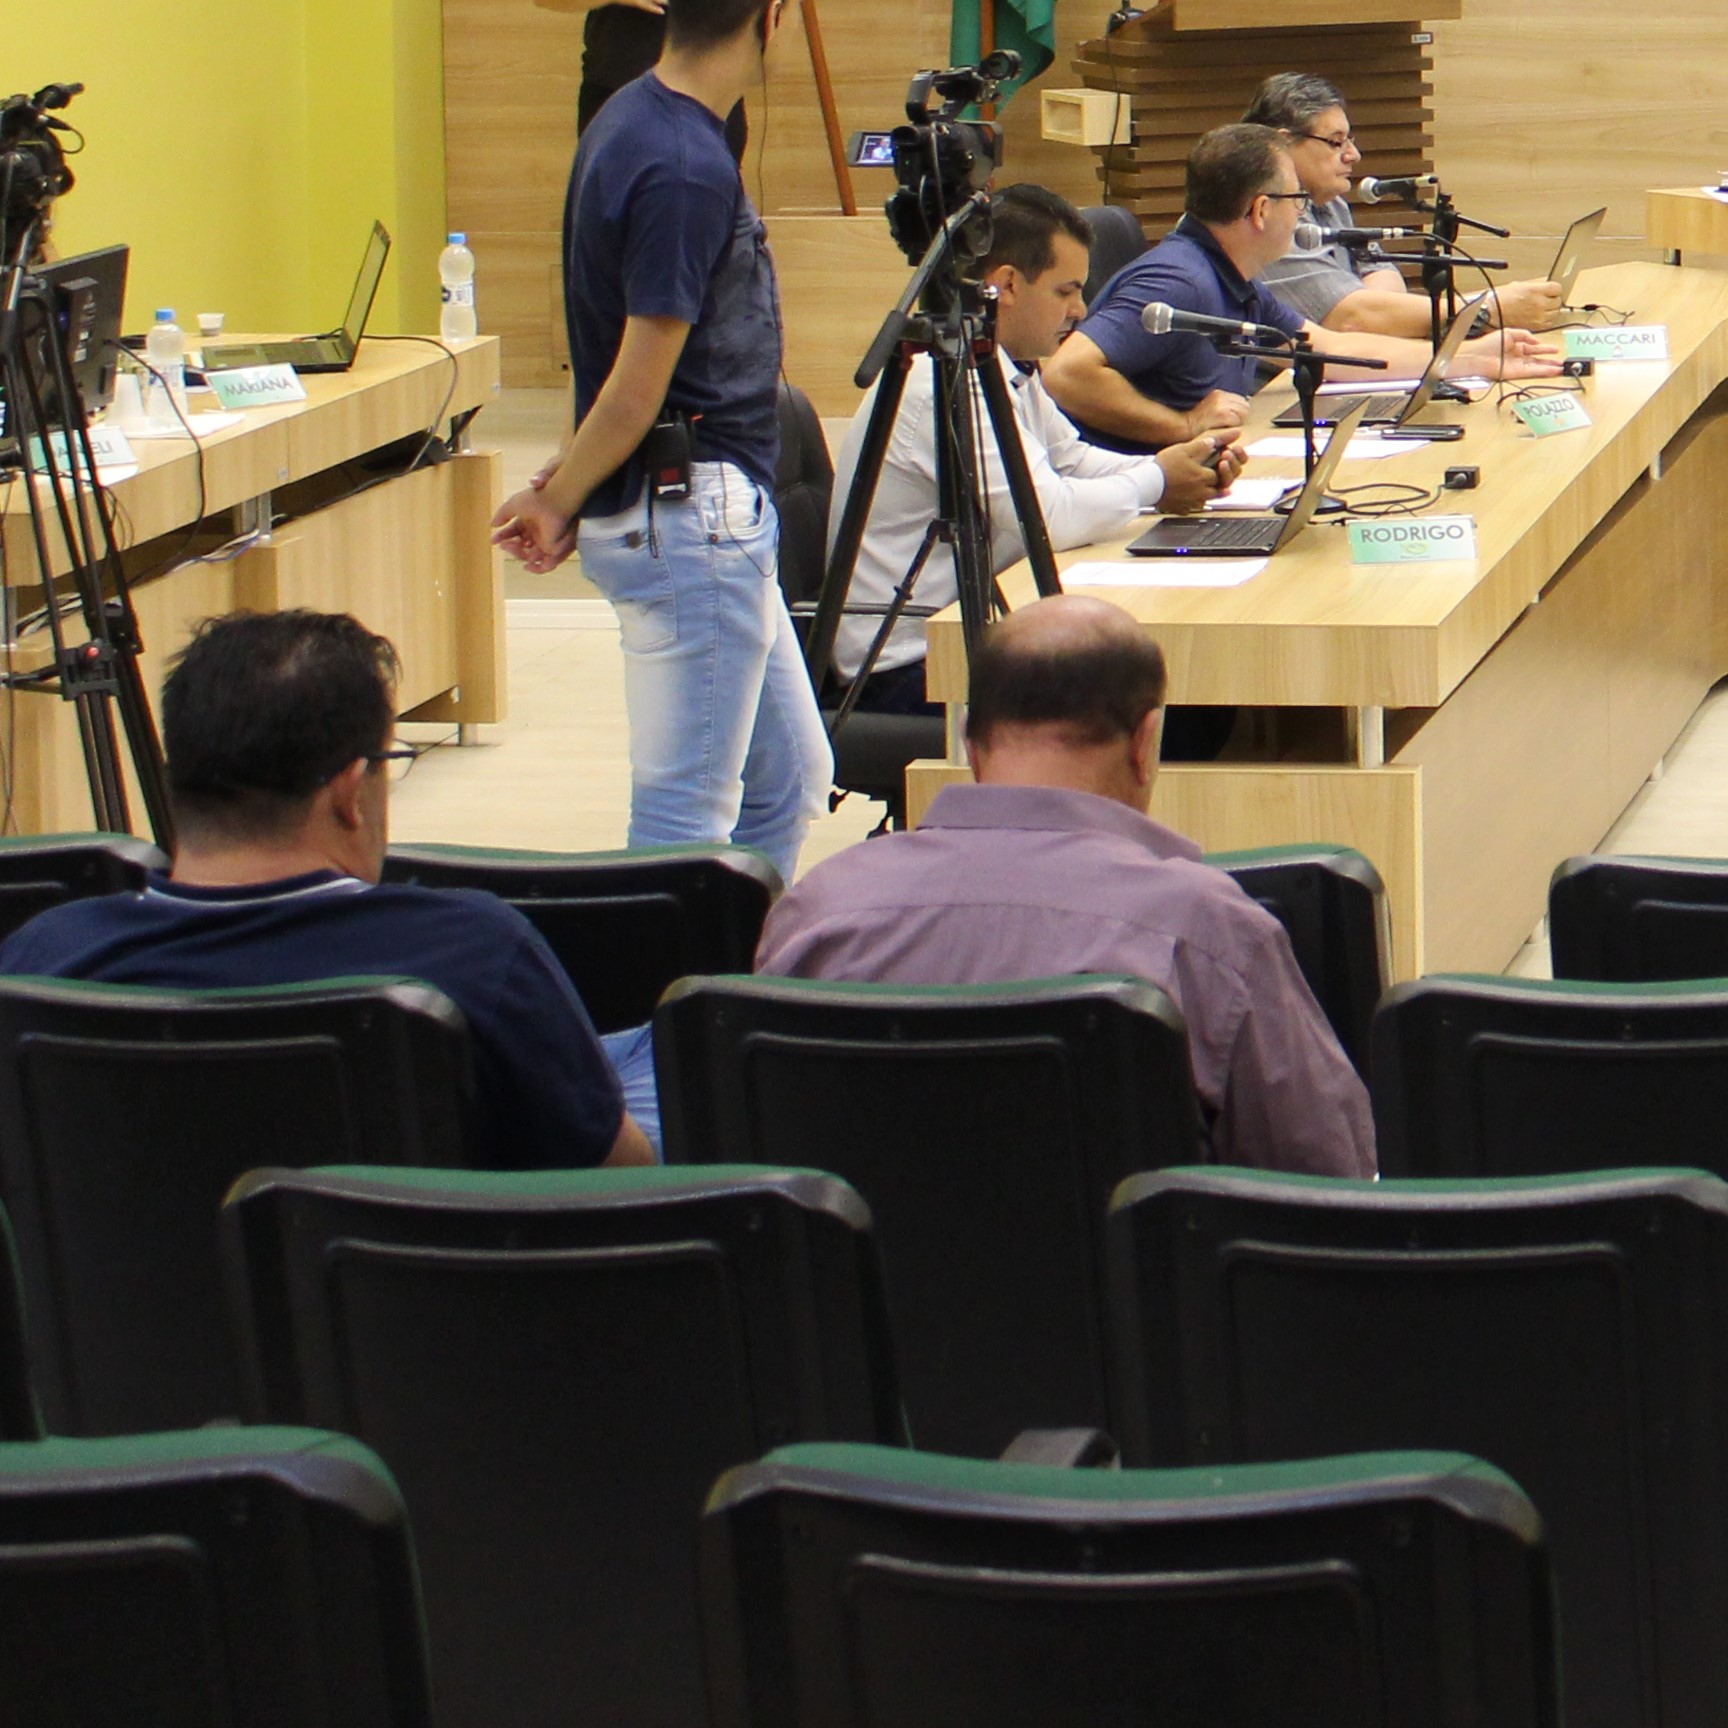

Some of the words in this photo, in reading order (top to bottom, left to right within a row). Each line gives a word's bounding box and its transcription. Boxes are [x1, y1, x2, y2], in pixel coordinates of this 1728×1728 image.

[1576, 333, 1656, 346] MACCARI
[1523, 398, 1575, 417] POLAZZO
[1360, 524, 1464, 543] RODRIGO
